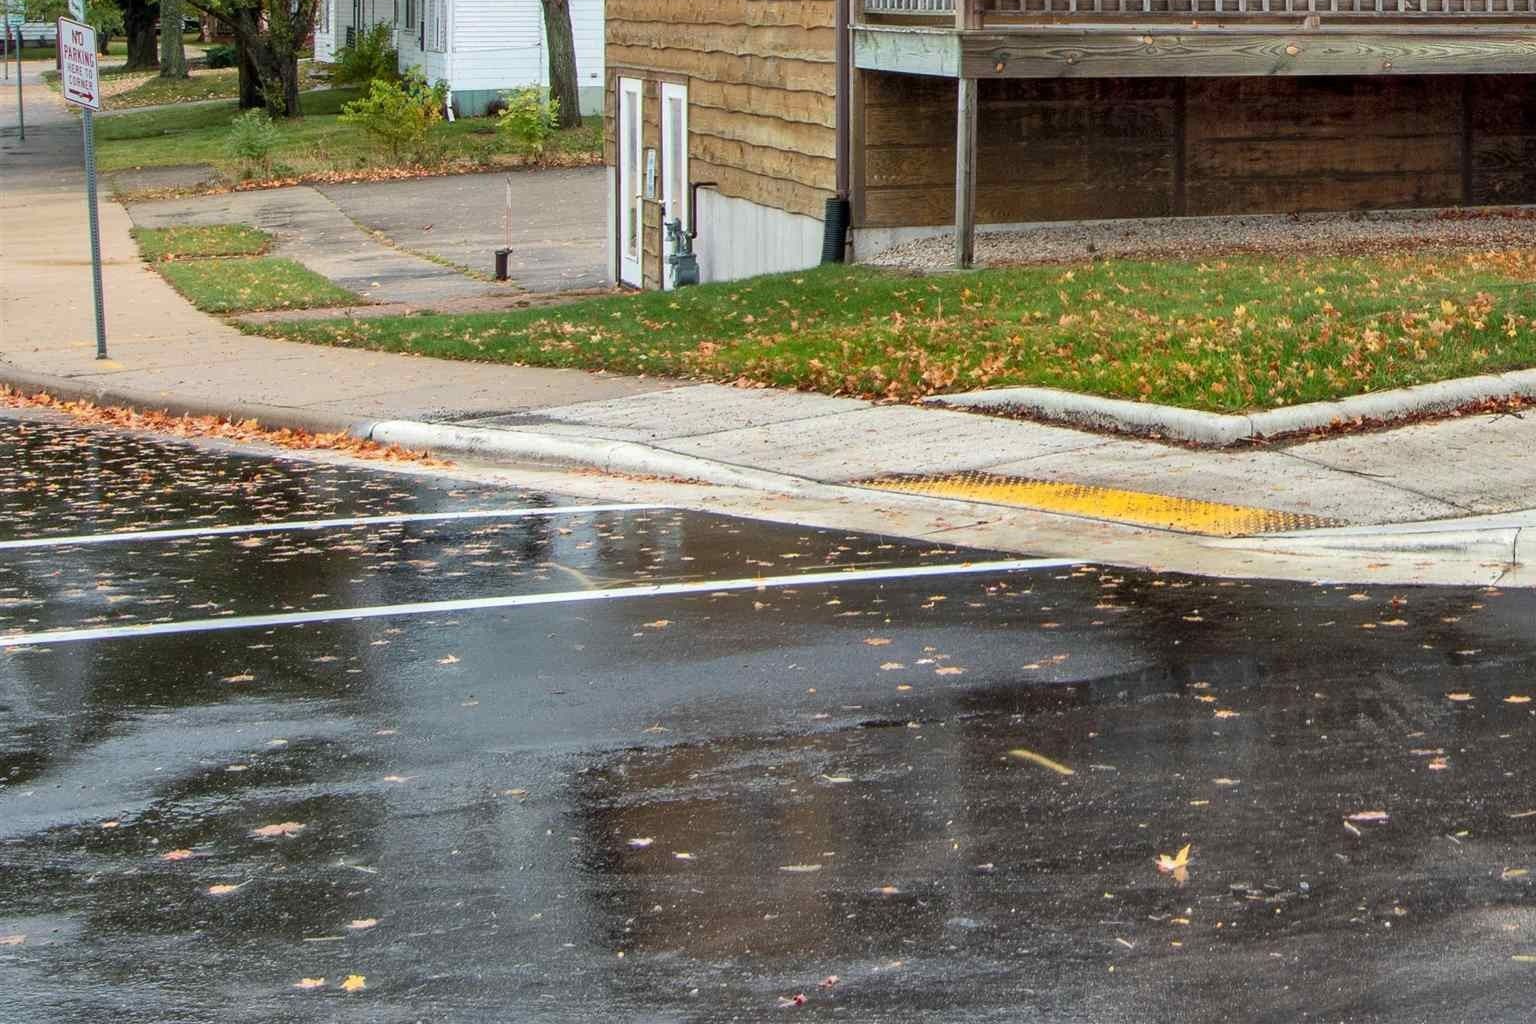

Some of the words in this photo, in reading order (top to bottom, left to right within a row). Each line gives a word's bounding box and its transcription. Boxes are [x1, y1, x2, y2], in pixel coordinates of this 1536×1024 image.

[72, 29, 84, 46] NO
[64, 45, 94, 67] PARKING
[67, 62, 83, 77] HERE
[85, 67, 94, 80] TO
[69, 75, 93, 91] CORNER
